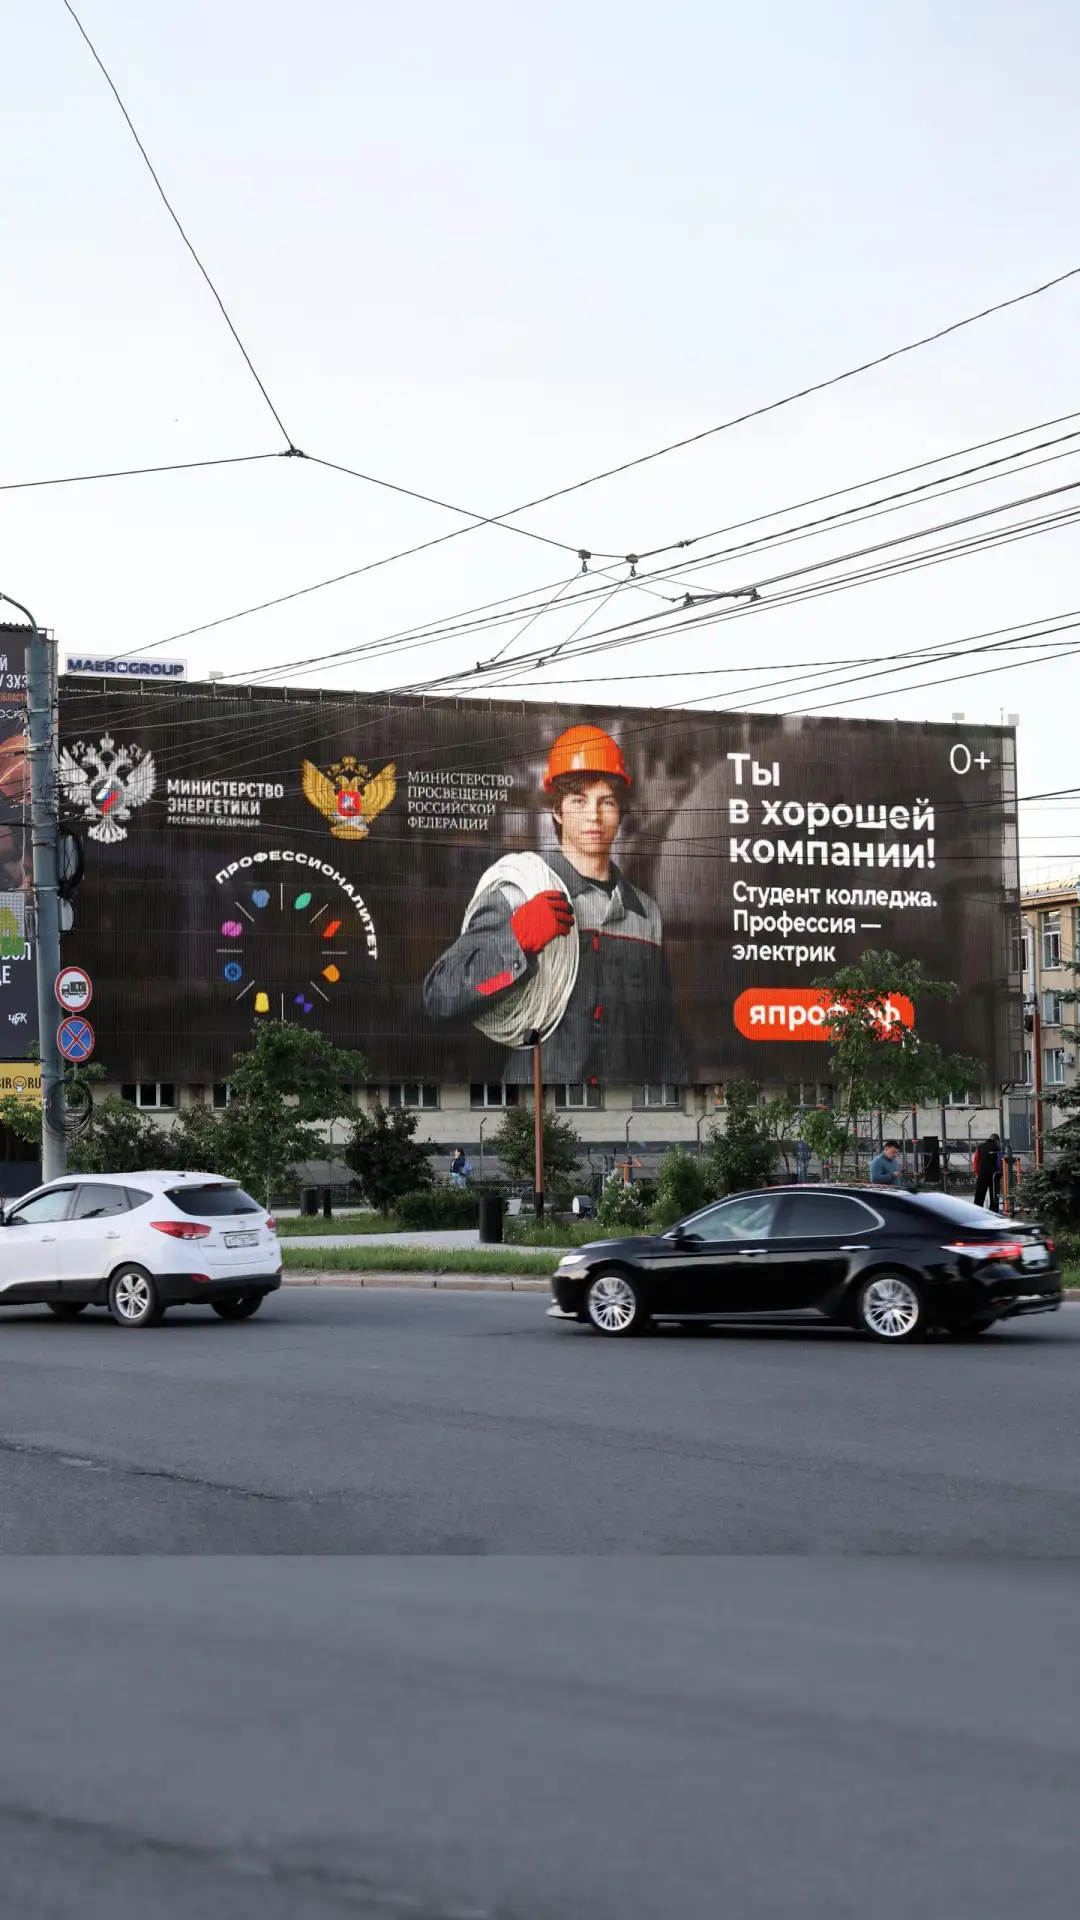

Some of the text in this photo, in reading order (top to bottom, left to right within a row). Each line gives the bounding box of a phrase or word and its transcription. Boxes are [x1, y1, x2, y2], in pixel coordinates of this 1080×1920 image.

[727, 753, 780, 786] Ты
[950, 743, 991, 775] 0+
[167, 779, 284, 798] МИНИСТЕРСТВО
[408, 771, 515, 786] МИНИСТЕРСТВО
[167, 797, 260, 815] ЭНЕРГЕТИКИ
[408, 786, 508, 801] ПРОСВЕЩЕНИЯ
[408, 801, 496, 816] РОССИЙСКОЙ
[761, 797, 935, 834] хорошей
[407, 816, 489, 831] ФЕДЕРАЦИИ
[729, 838, 936, 869] компании!
[215, 850, 378, 960] ПРОФЕССИОНАЛИТЕТ
[733, 881, 937, 908] Студент колледжа.
[733, 909, 856, 937] Профессия
[732, 943, 836, 966] электрик
